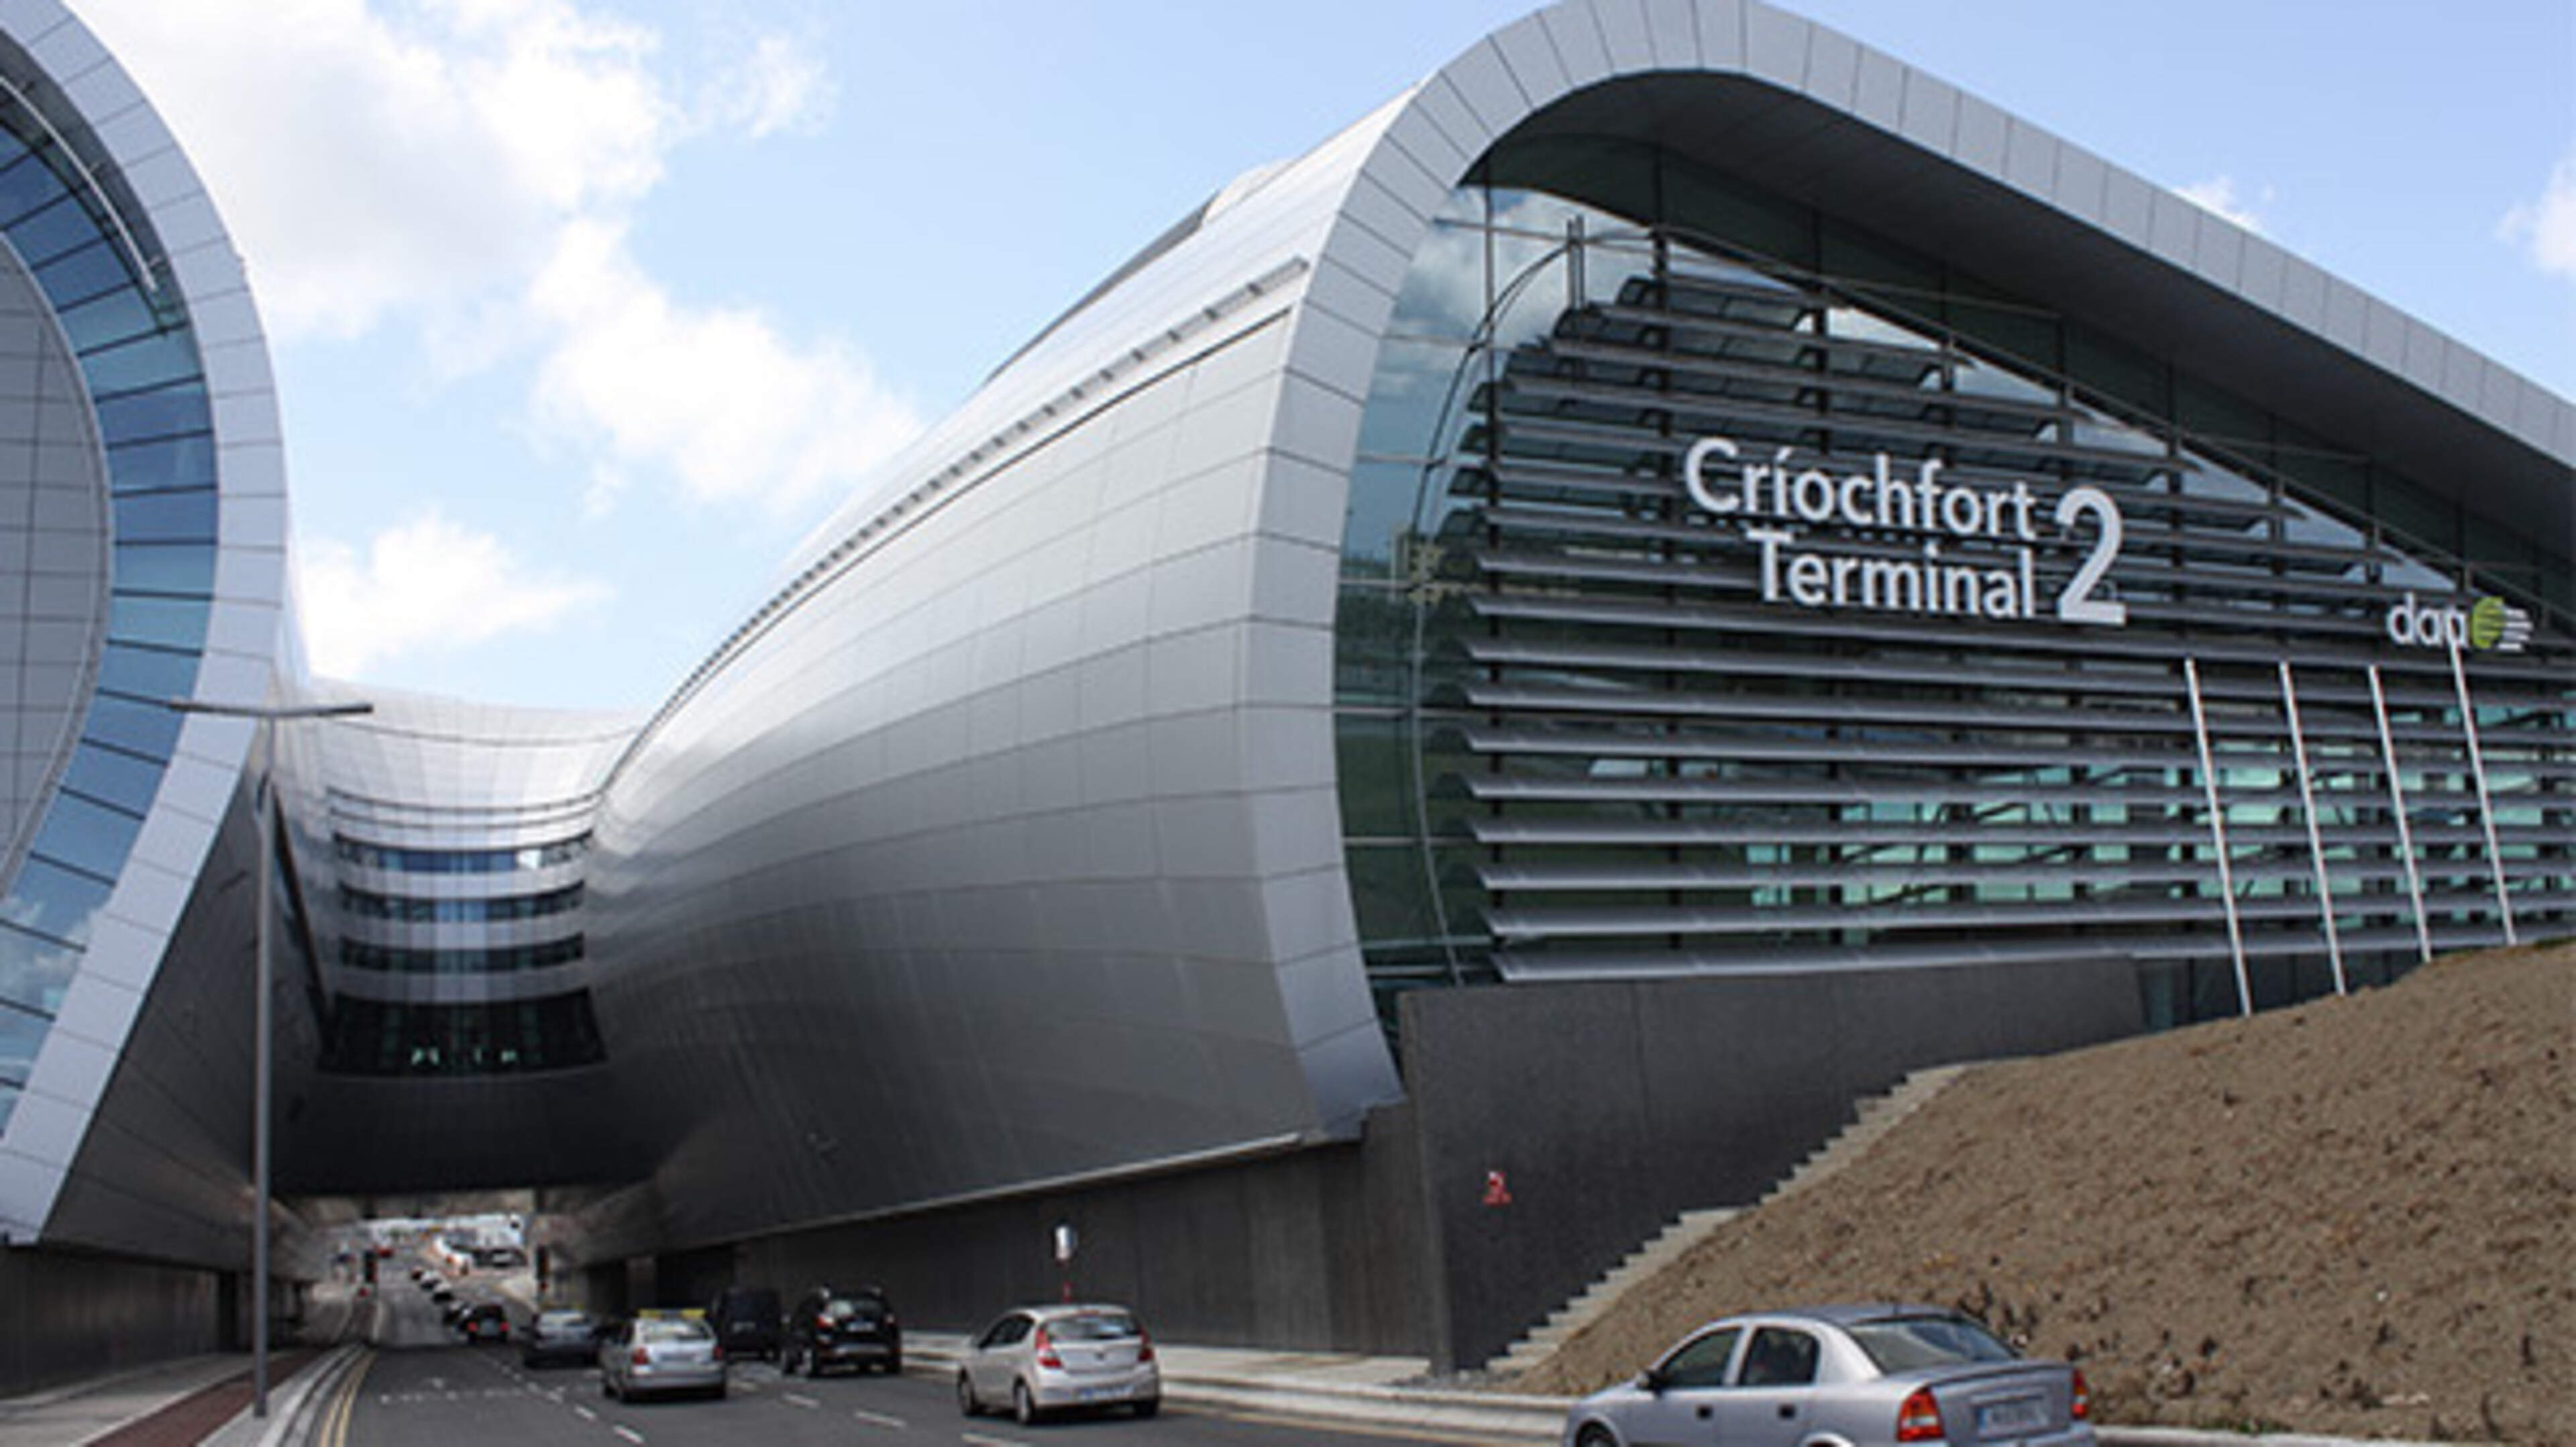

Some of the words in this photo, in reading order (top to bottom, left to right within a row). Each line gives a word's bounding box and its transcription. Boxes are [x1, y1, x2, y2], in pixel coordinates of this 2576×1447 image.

[1684, 437, 2037, 540] Críochfort
[1747, 527, 2035, 619] Terminal
[2055, 488, 2127, 625] 2
[2386, 592, 2469, 647] daa
